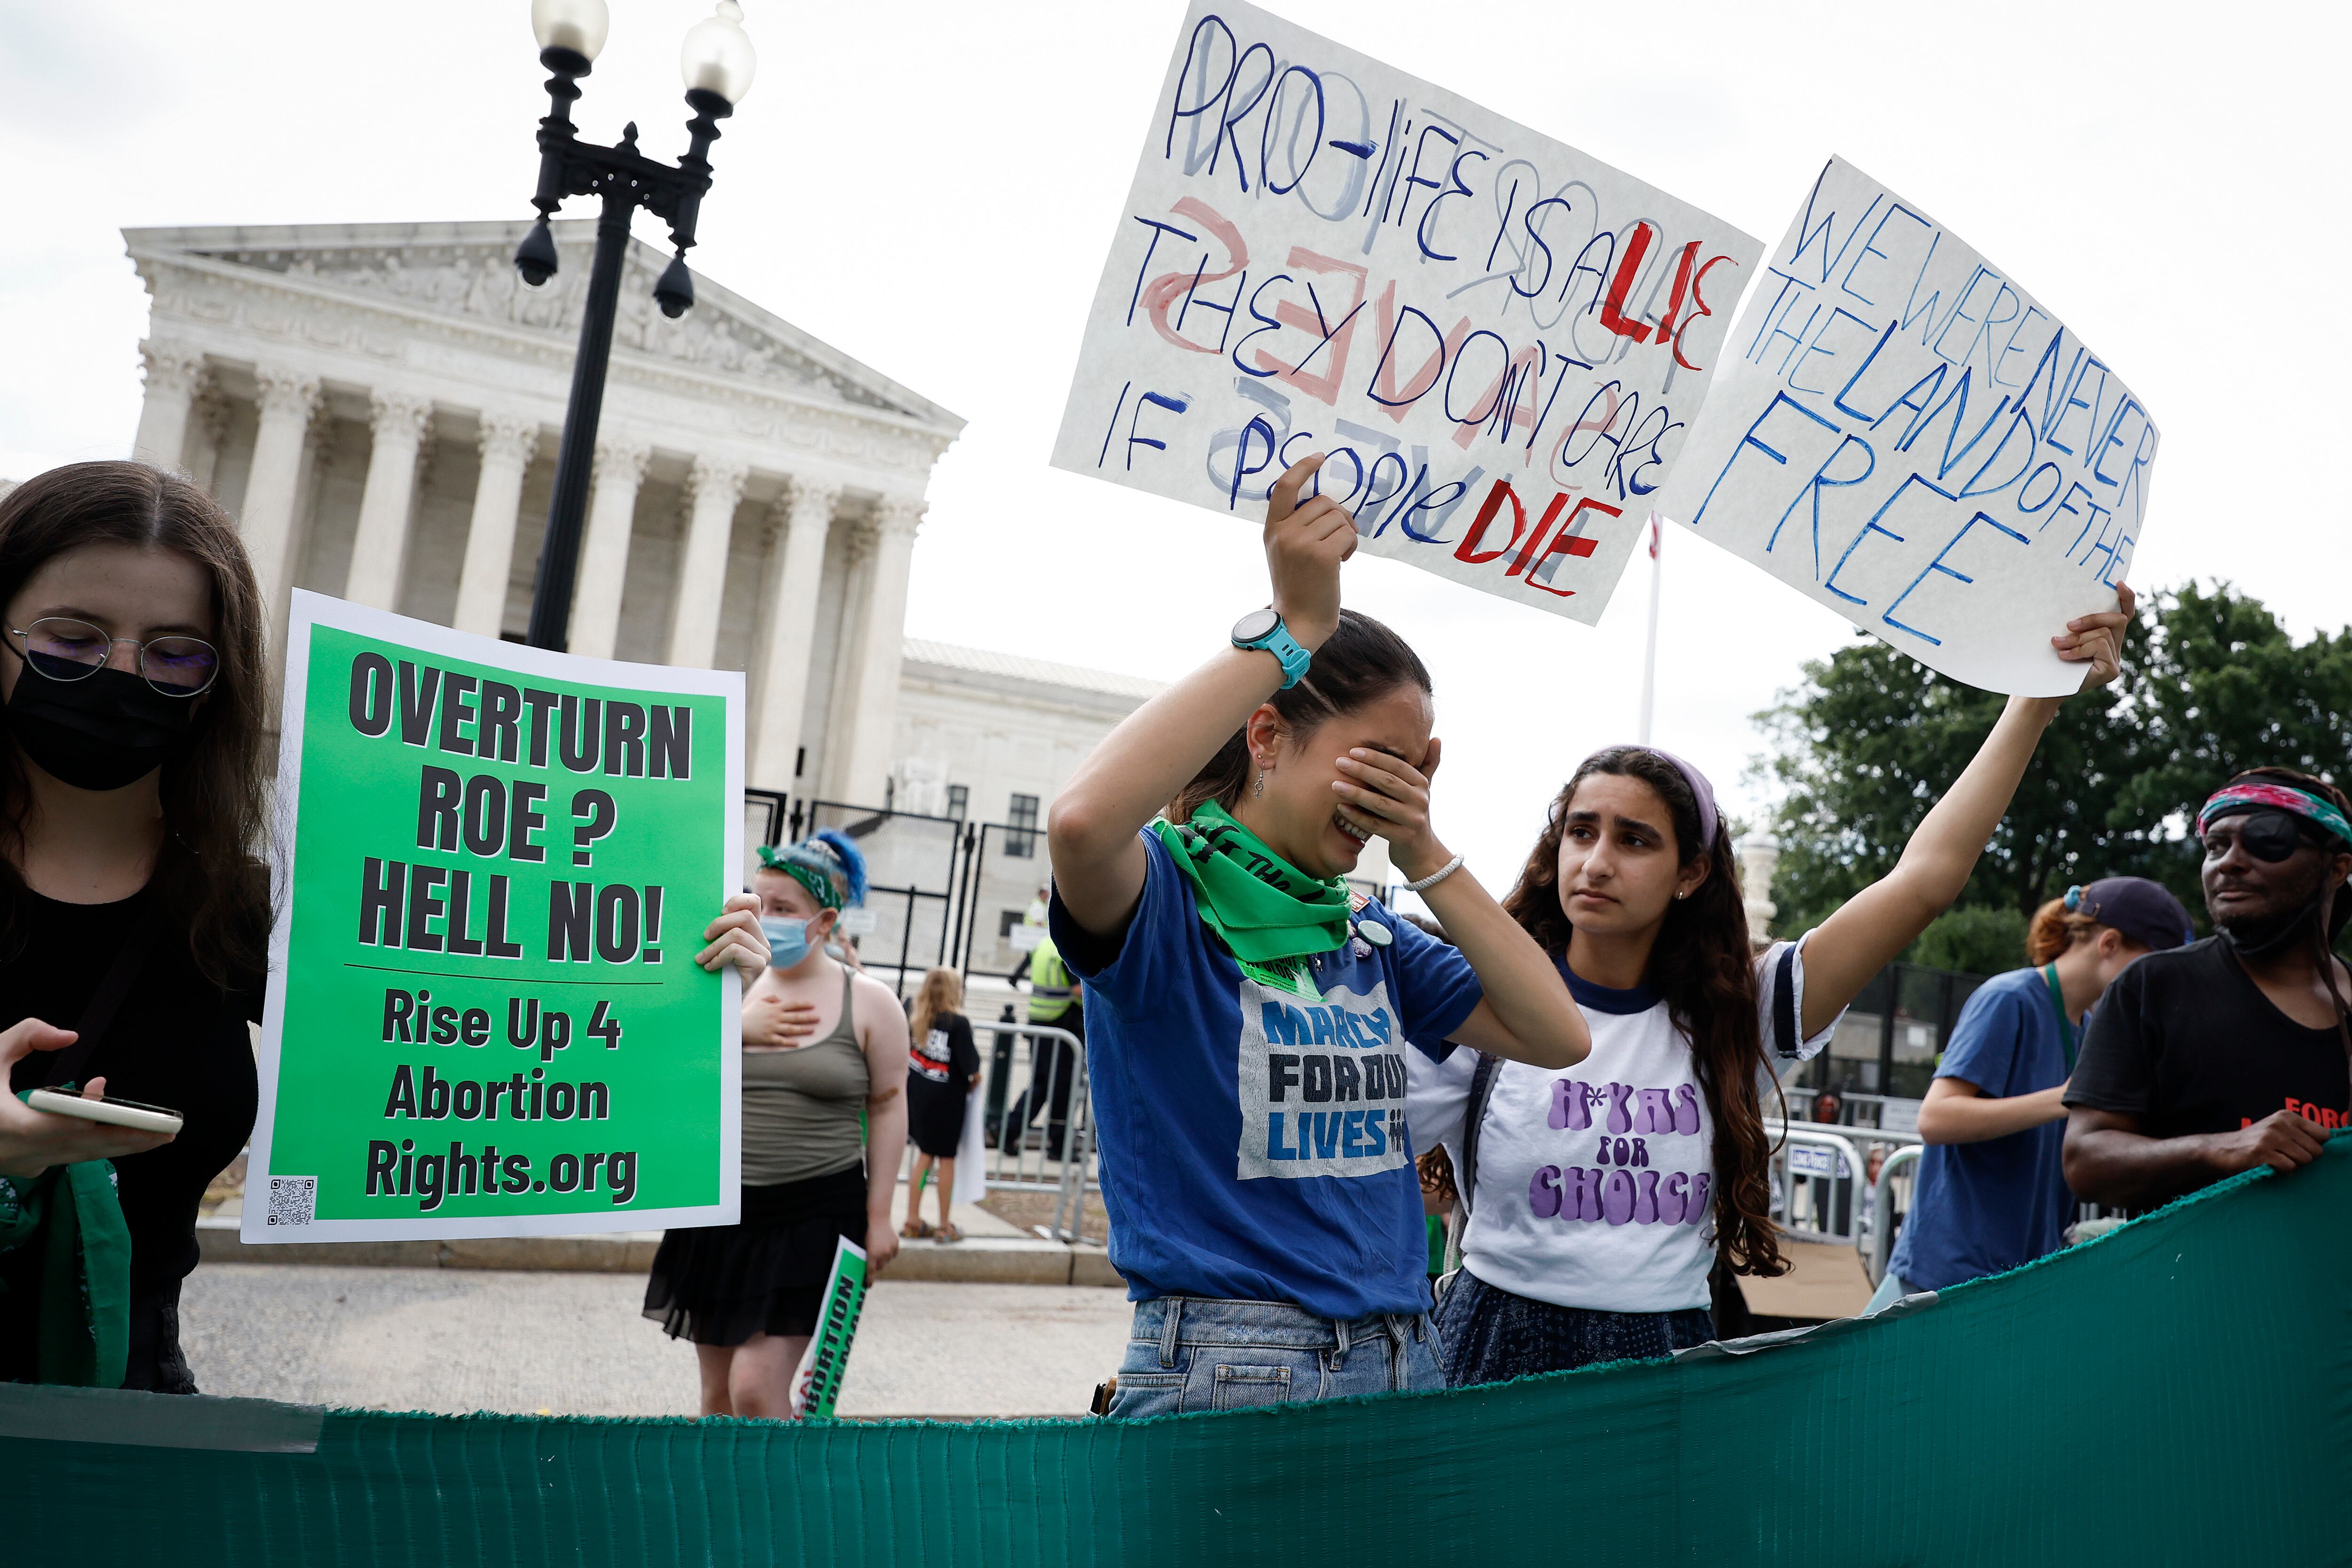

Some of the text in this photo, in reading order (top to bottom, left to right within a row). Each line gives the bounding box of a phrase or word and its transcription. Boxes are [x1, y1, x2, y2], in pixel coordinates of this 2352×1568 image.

[1486, 180, 1571, 297] IS
[1559, 231, 1614, 302] A
[1599, 221, 1739, 371] LIE
[1126, 216, 1685, 500] THEY DON'T CARE
[1790, 159, 2156, 527] WE WERE NEVER
[1747, 266, 2135, 590] THE LAND OF THE
[1098, 382, 1191, 470] IF
[1454, 479, 1623, 597] DIE
[1693, 390, 2030, 645] FREE
[349, 651, 692, 781] OVERTURN
[415, 764, 617, 867] ROE ?
[358, 856, 664, 965] HELL NO!
[381, 988, 621, 1061] Rise Up 4
[1269, 1053, 1362, 1103] FOR
[383, 1063, 610, 1121] Abortion
[1267, 1109, 1386, 1160] LIVES
[365, 1139, 637, 1212] Rights.org
[1528, 1165, 1710, 1226] CHOICE
[1597, 1136, 1649, 1167] FOR
[803, 1274, 857, 1414] BORTION
